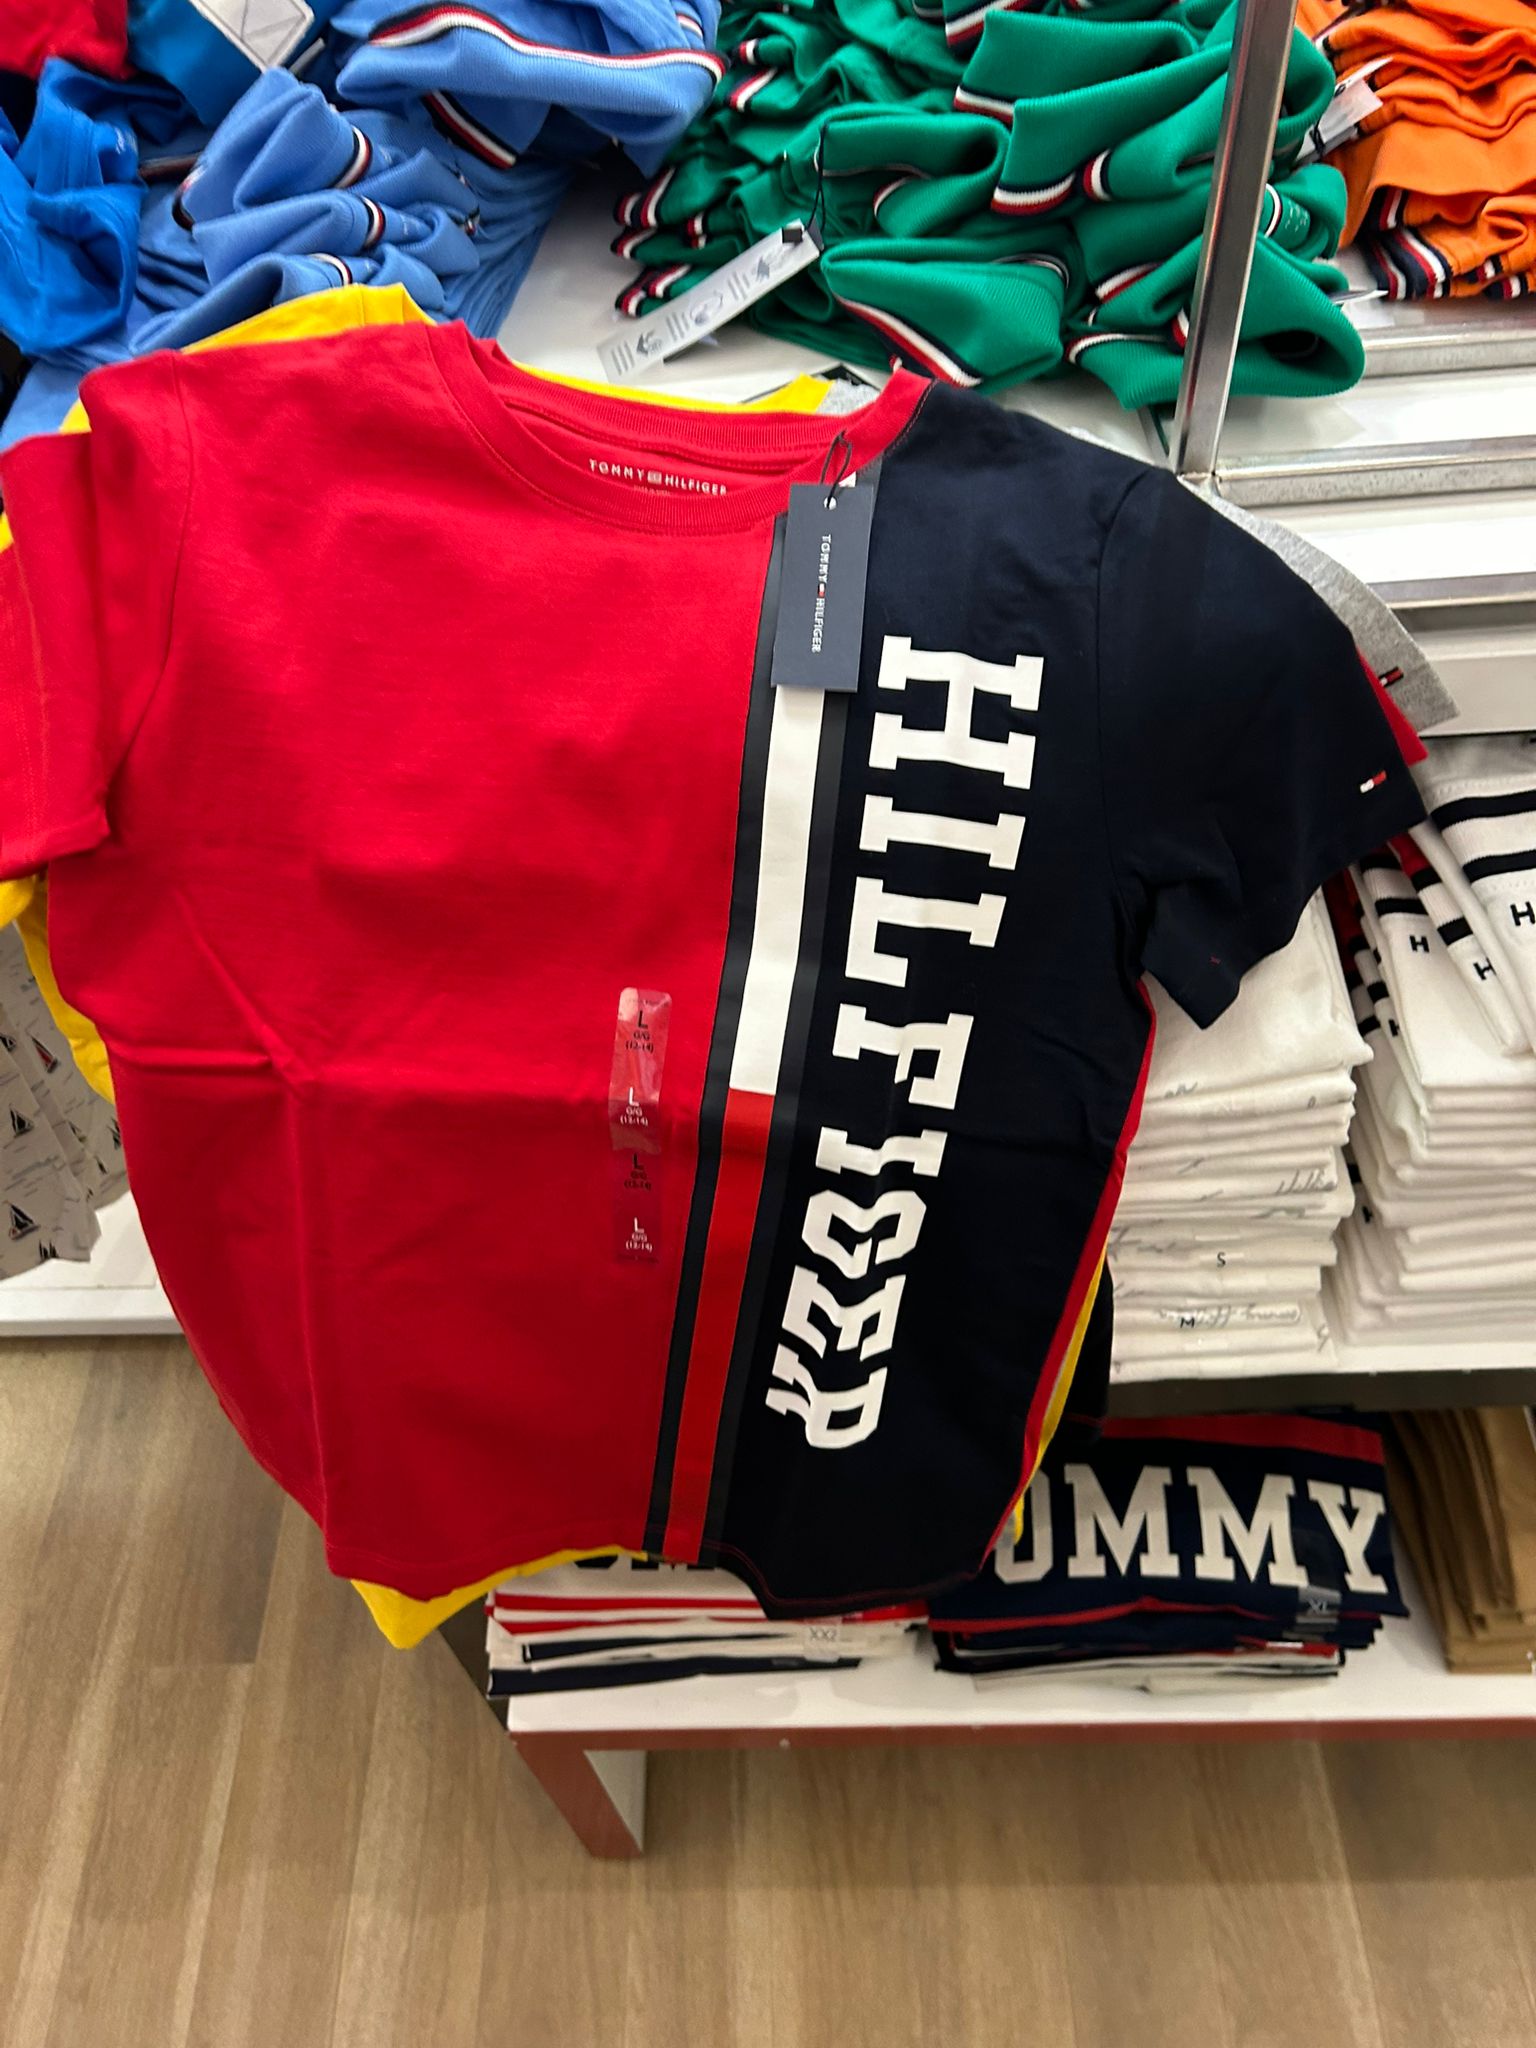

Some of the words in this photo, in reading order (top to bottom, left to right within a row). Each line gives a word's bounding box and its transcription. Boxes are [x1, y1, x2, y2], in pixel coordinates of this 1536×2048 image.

[589, 458, 645, 482] TOMMY
[664, 474, 727, 495] HILFIGER
[817, 533, 832, 585] TOMMY
[810, 597, 826, 653] HILFIGER
[1510, 901, 1536, 926] H
[1409, 935, 1430, 953] H
[1473, 957, 1497, 980] H
[638, 1010, 648, 1029] L
[765, 635, 1045, 1451] HILFIGER
[629, 1087, 640, 1107] L
[634, 1217, 645, 1234] L
[1217, 1252, 1226, 1267] S
[1180, 1317, 1195, 1329] M
